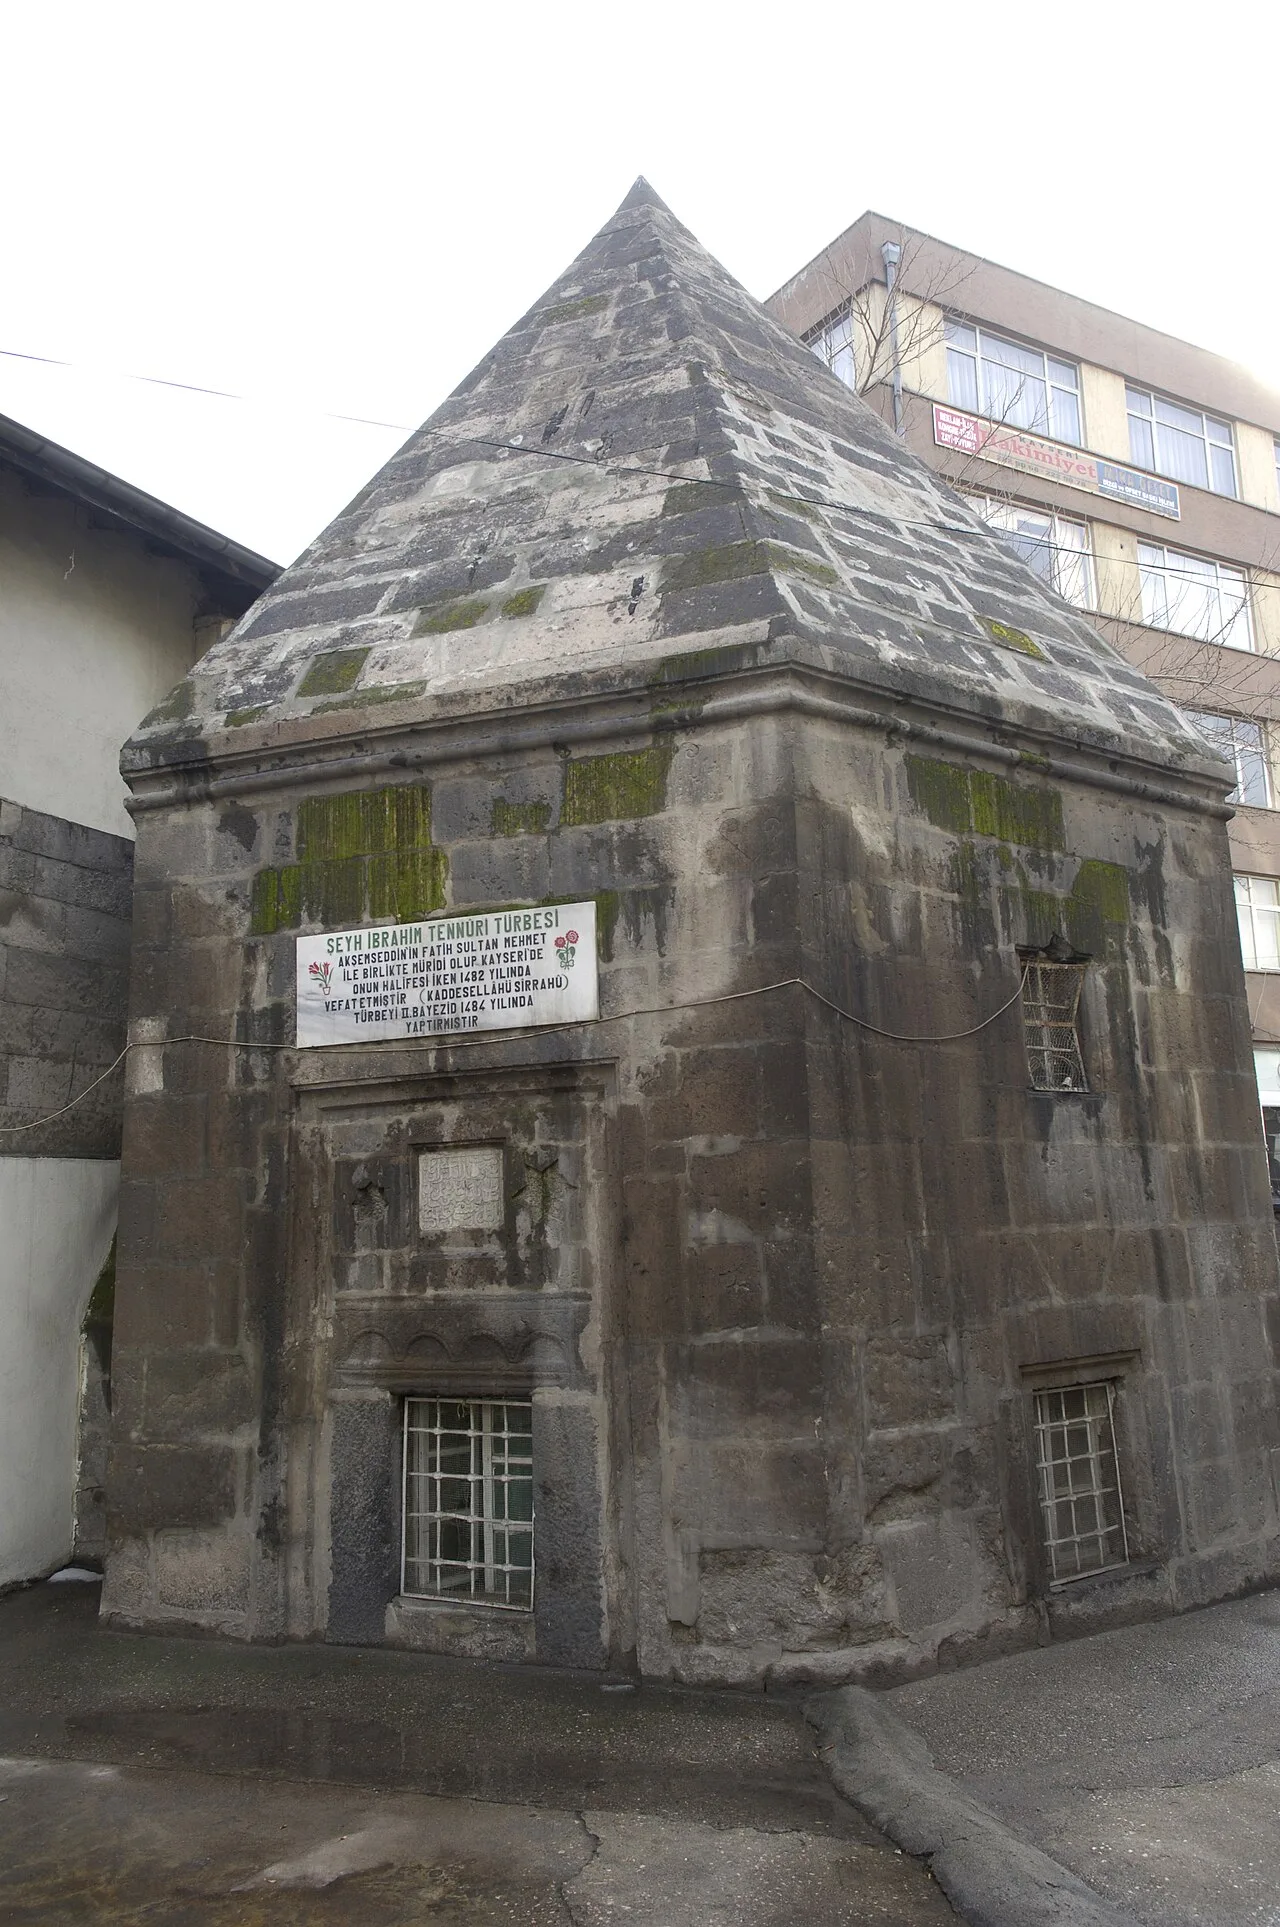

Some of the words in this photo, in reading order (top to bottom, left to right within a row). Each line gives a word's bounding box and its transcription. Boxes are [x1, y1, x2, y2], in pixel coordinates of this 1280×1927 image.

[326, 934, 362, 956] ŞEYH
[367, 926, 422, 949] İBRAHİM
[494, 908, 559, 935] TÜRBESİ
[422, 940, 453, 958] FATİH
[456, 937, 498, 954] SULTAN
[504, 932, 547, 948] MEHMET
[343, 967, 359, 981] İLE
[362, 963, 409, 980] BİRLİKTE
[412, 957, 446, 974] MÜRİDİ
[450, 955, 477, 970] OLUP
[352, 981, 379, 995] ONUN
[382, 974, 429, 990] HALİFESİ
[432, 968, 457, 986] İKEN
[460, 969, 485, 983] 1482
[489, 964, 531, 981] YILINDA
[354, 1004, 398, 1023] TÜRBEYİ
[460, 999, 486, 1014] 1484
[490, 994, 534, 1010] YILINDA
